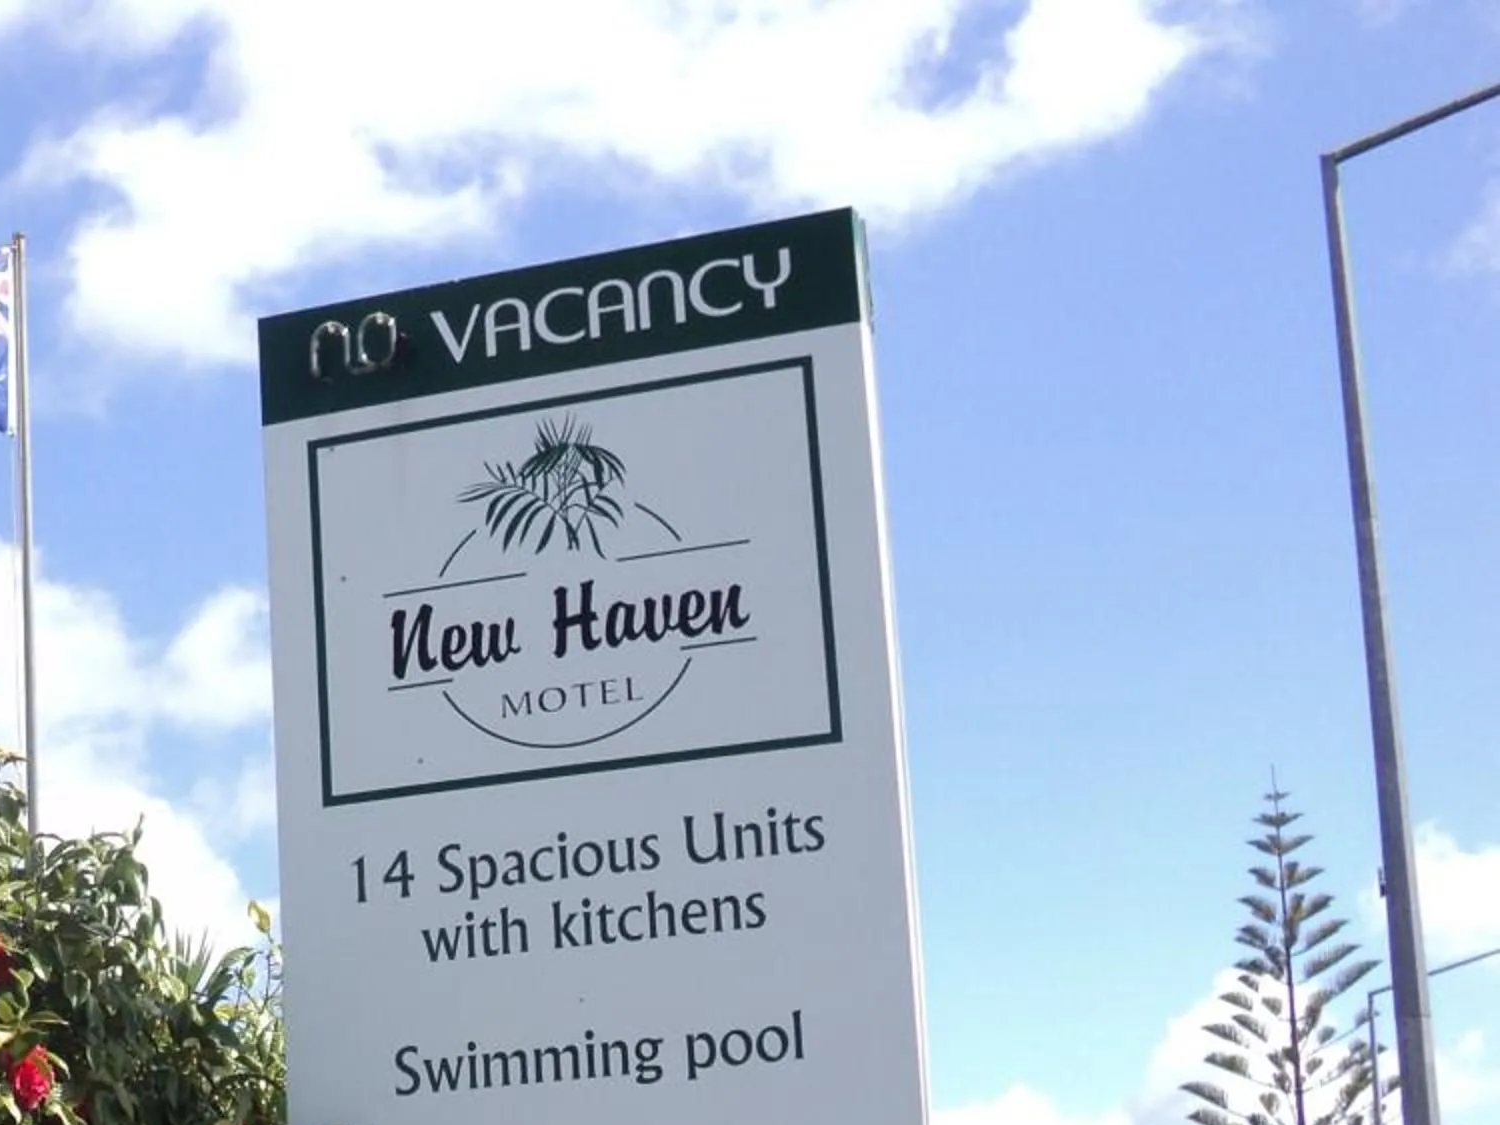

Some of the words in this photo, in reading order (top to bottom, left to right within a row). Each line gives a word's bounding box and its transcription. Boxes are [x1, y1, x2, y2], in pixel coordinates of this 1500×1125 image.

[390, 603, 522, 681] New
[552, 579, 750, 659] Haven
[500, 675, 644, 719] MOTEL
[353, 850, 415, 904] 14
[437, 831, 661, 900] Spacious
[683, 807, 825, 865] Units
[421, 905, 529, 963] with
[551, 890, 767, 949] kitchens
[394, 1029, 664, 1096] Swimming
[685, 1009, 804, 1081] pool
